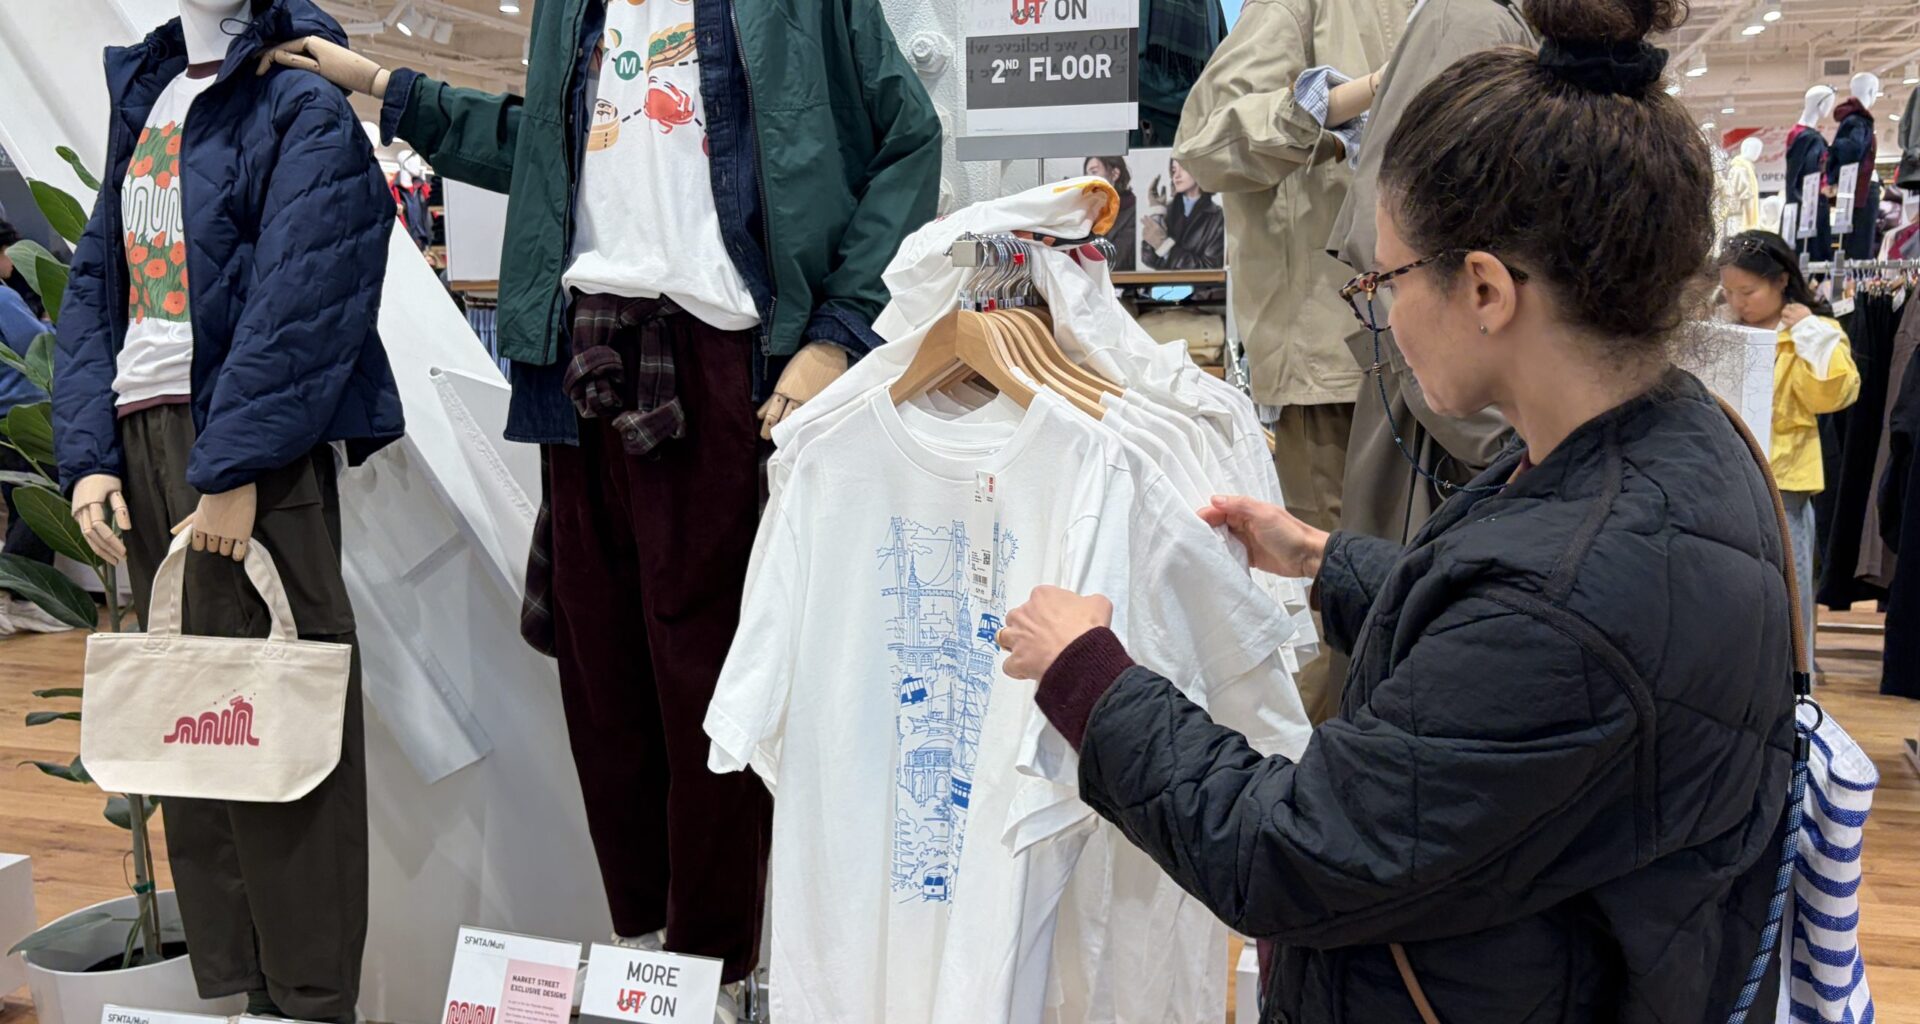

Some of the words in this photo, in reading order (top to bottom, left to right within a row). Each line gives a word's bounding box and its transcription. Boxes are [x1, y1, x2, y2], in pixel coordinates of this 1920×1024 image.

[1054, 0, 1087, 20] ON
[618, 57, 638, 74] M
[1029, 54, 1112, 82] FLOOR
[512, 974, 536, 985] MARKET
[537, 978, 560, 988] STREET
[627, 960, 681, 988] MORE
[510, 984, 541, 996] EXCLUSIVE
[543, 989, 567, 999] DESIGNS
[650, 994, 677, 1018] ON
